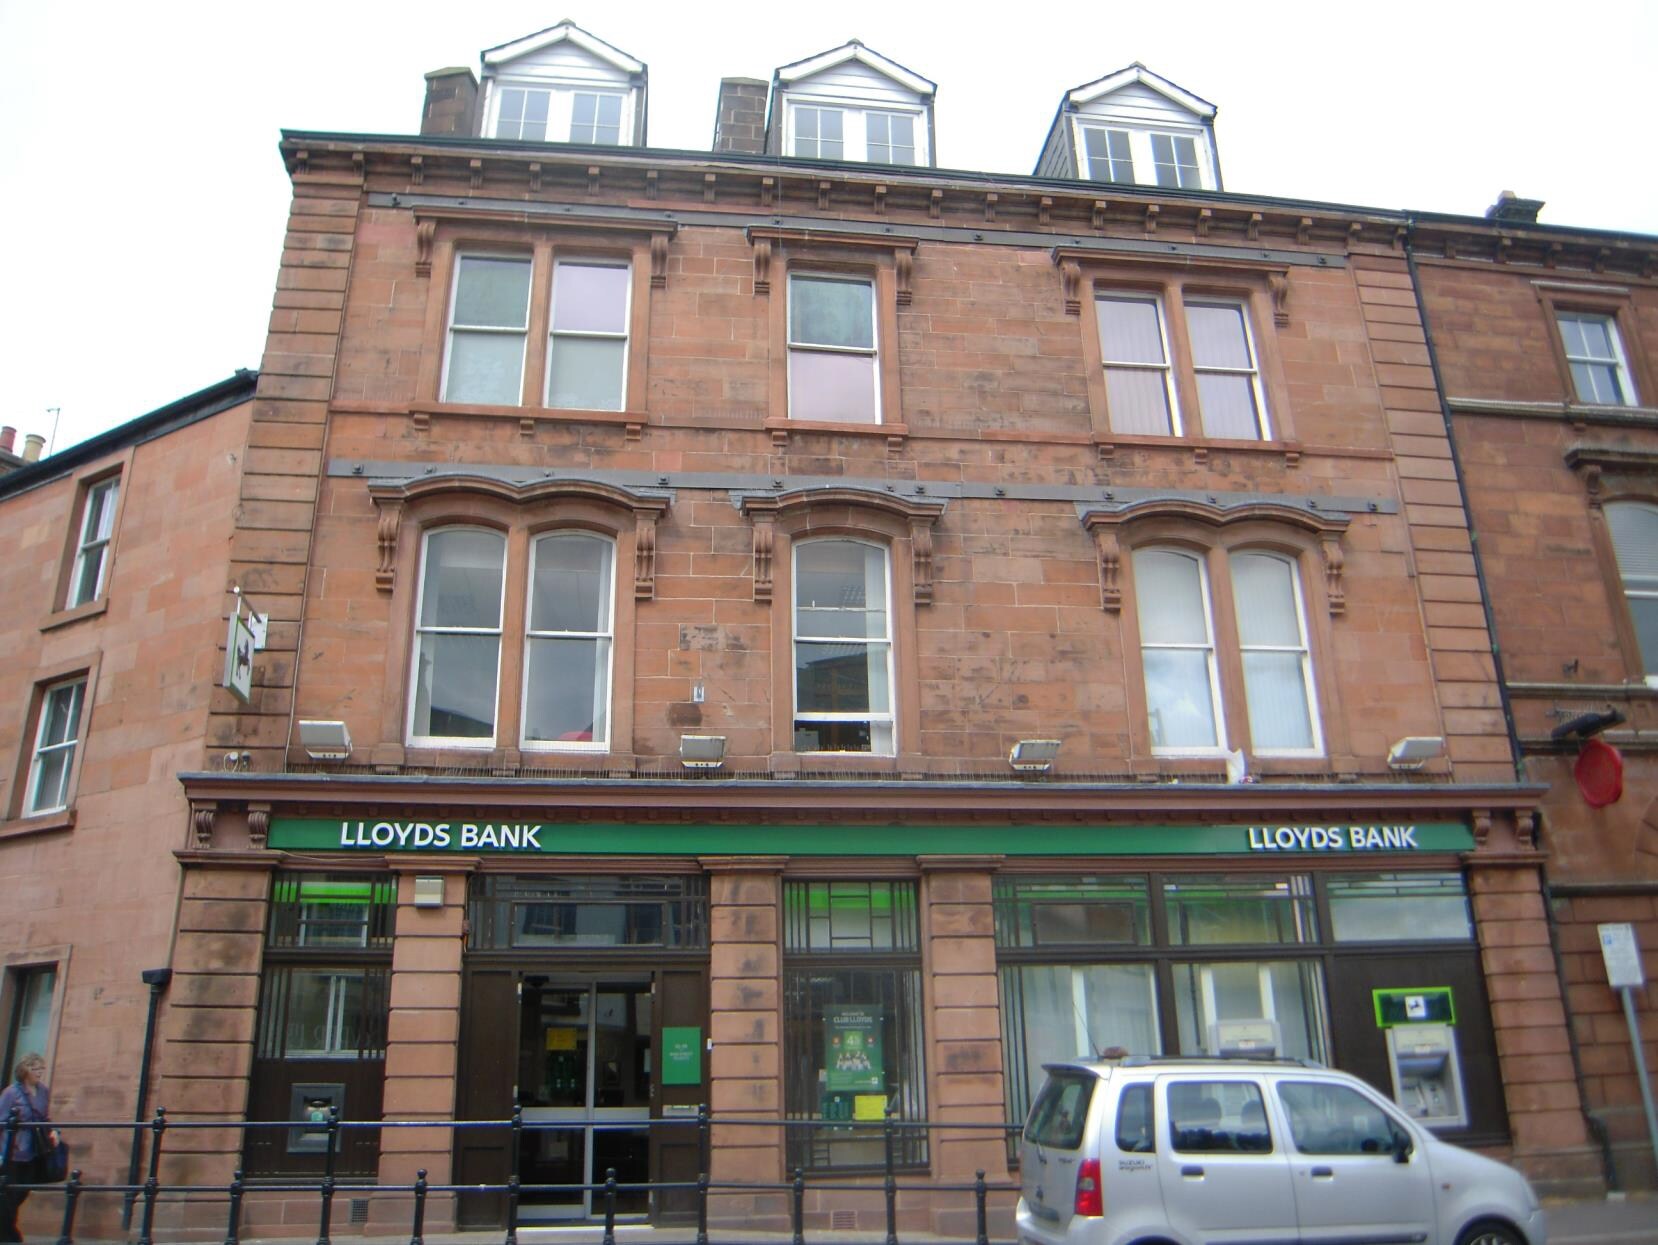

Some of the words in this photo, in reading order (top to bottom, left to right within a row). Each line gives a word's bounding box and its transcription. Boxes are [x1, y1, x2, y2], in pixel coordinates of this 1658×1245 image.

[340, 821, 450, 847] LLOYDS
[460, 823, 542, 849] BANK
[1248, 826, 1344, 849] LLOYDS
[1349, 825, 1418, 848] BANK
